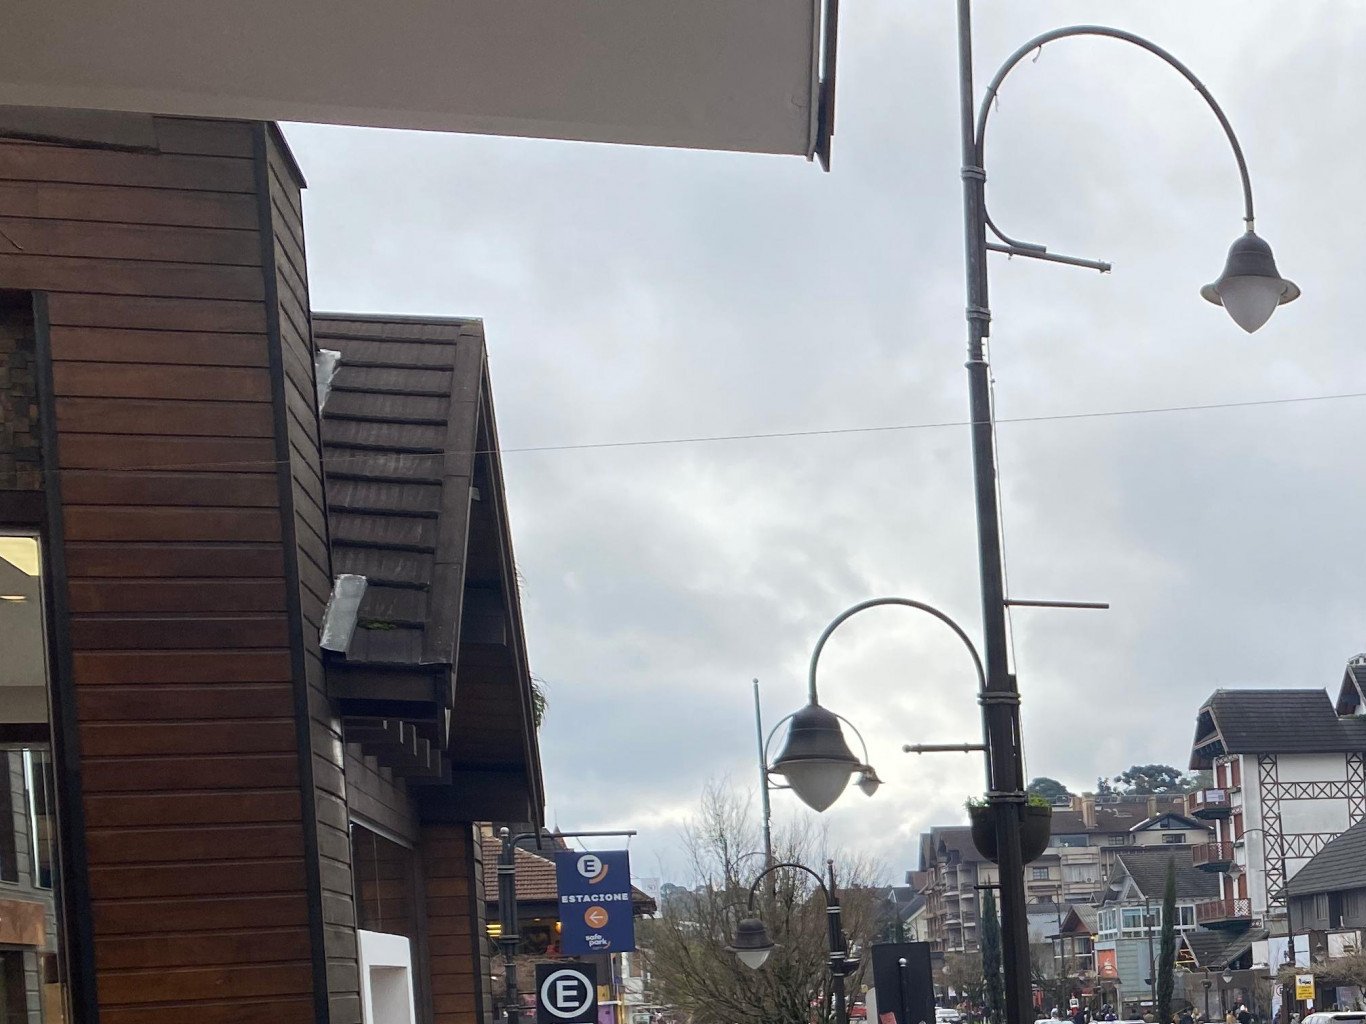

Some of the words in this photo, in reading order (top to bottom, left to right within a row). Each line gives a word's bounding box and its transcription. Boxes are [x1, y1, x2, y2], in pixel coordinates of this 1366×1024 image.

[583, 859, 596, 873] E
[561, 892, 629, 904] ESTACIONE
[585, 933, 602, 941] safe
[589, 938, 608, 947] park
[555, 979, 580, 1008] E
